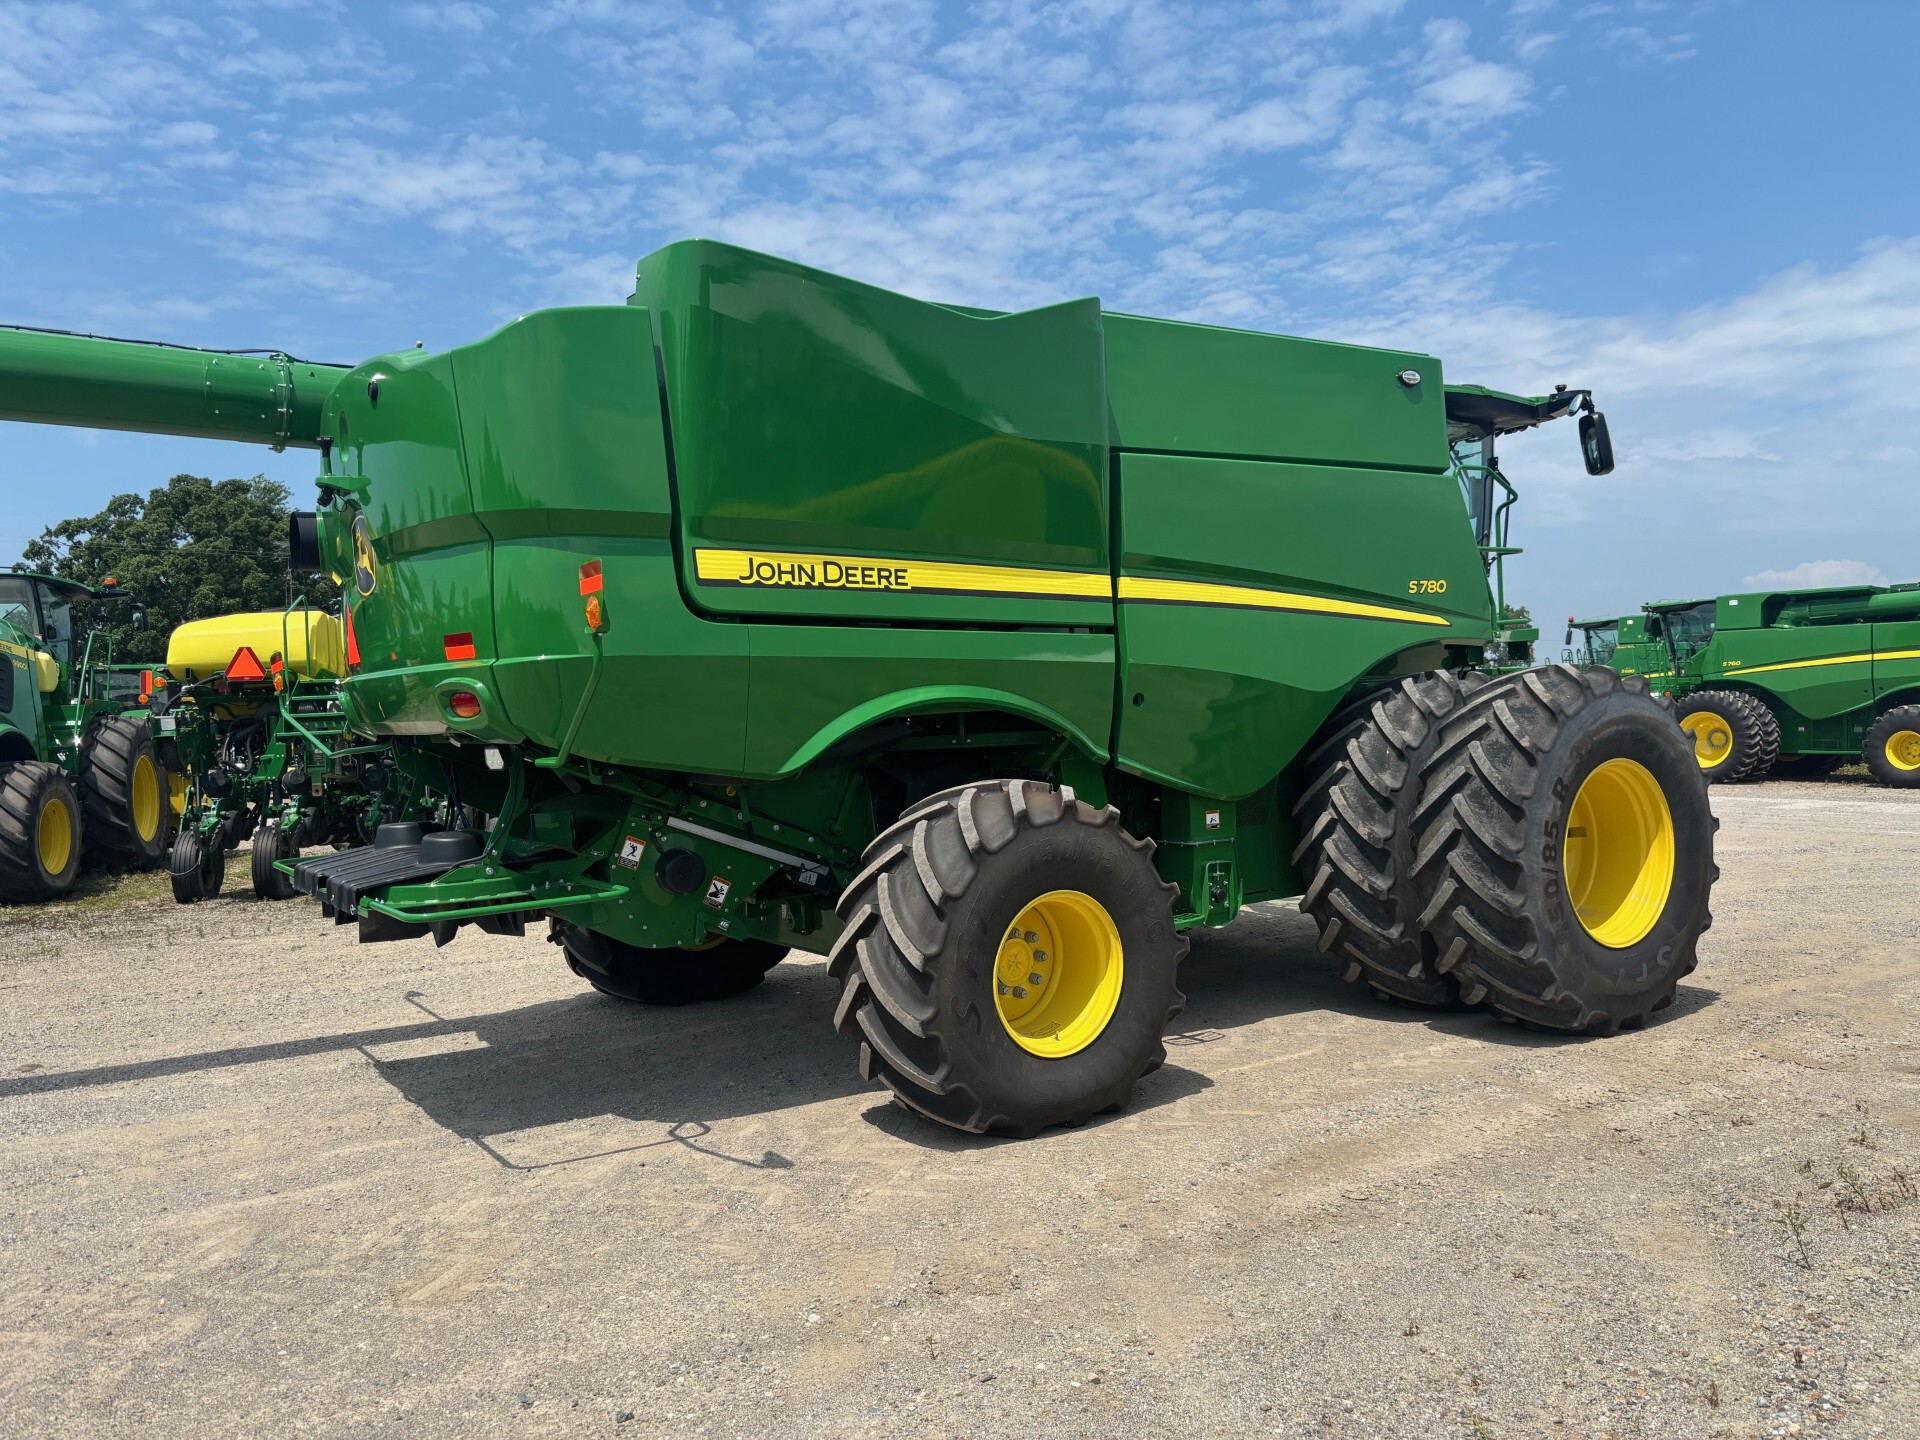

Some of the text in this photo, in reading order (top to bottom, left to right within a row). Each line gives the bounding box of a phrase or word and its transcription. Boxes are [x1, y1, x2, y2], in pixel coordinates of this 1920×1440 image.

[739, 557, 909, 587] JOHN DEERE
[1408, 579, 1448, 594] S780
